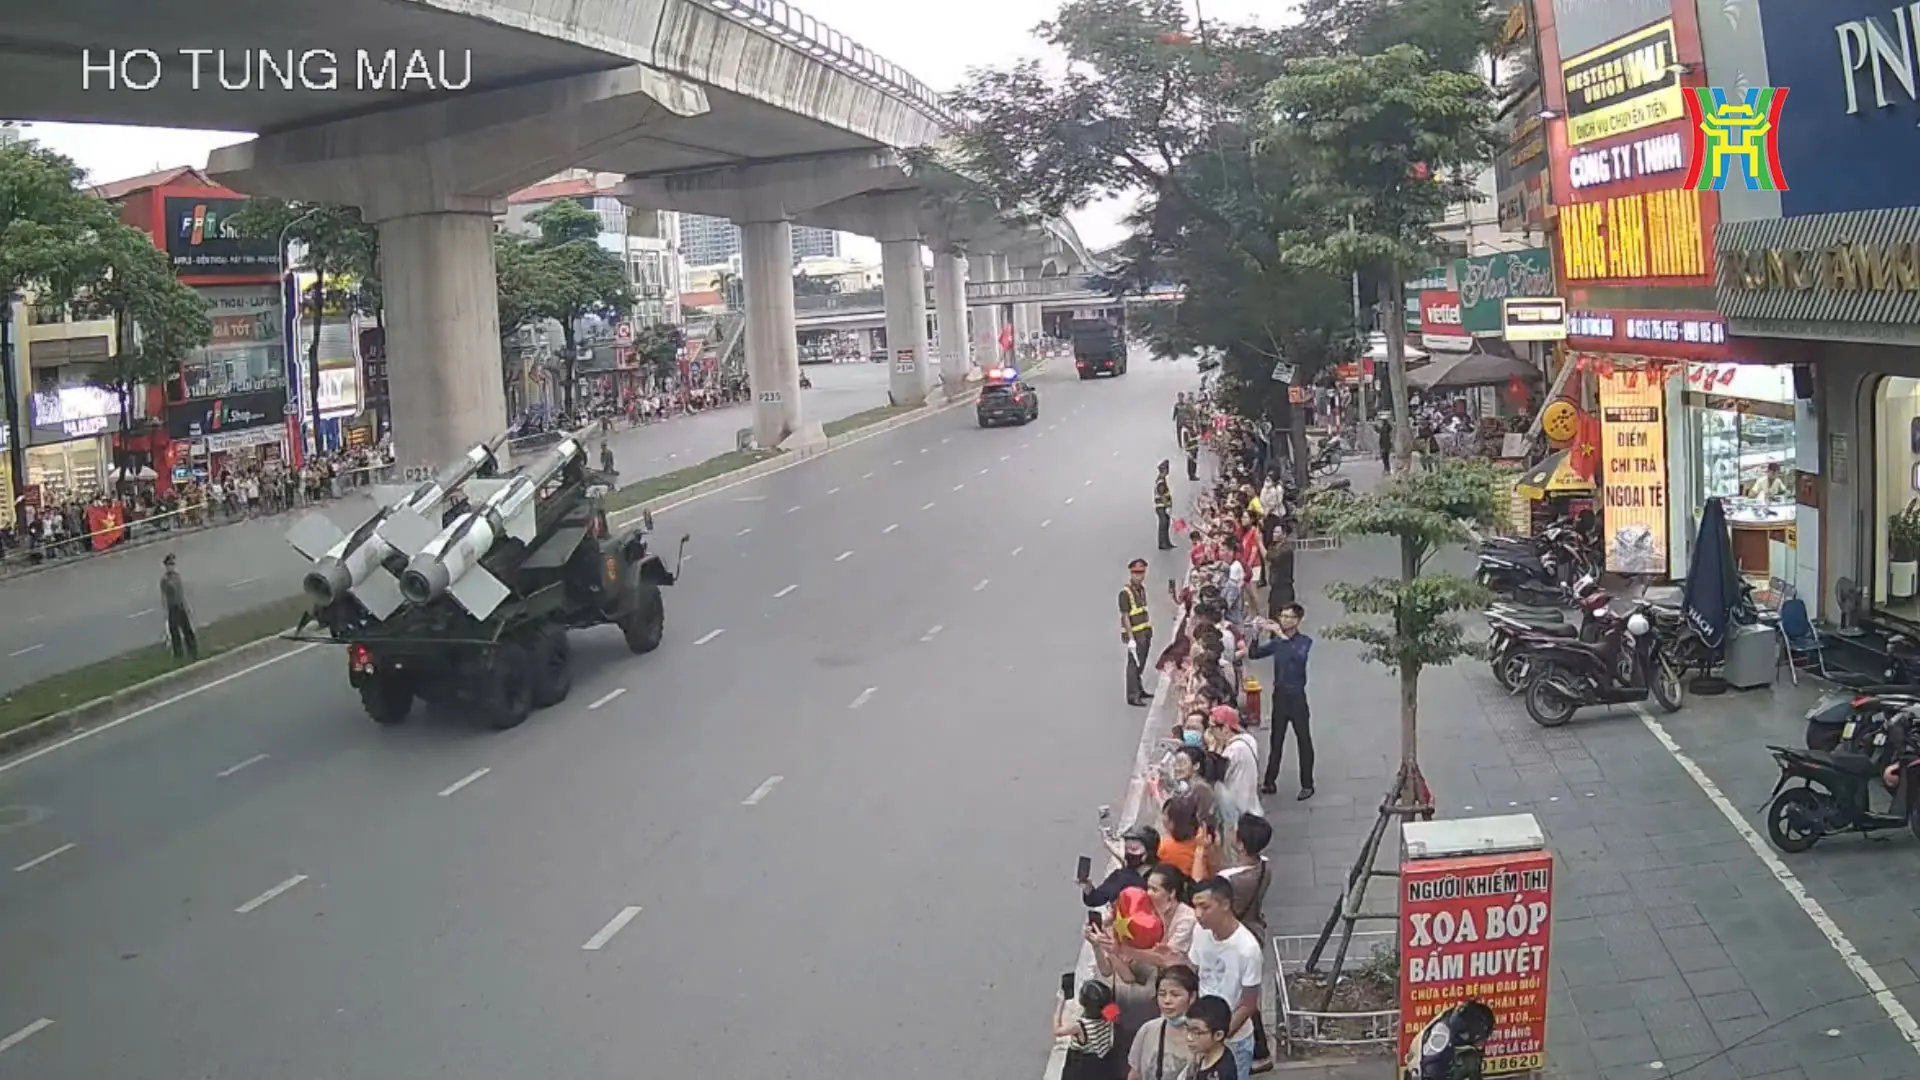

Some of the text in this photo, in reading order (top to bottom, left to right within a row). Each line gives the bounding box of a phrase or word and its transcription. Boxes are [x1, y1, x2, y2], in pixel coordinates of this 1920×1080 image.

[1566, 58, 1622, 92] WESTERN
[1584, 75, 1624, 104] UNION
[1569, 147, 1610, 189] CÔNG
[1611, 144, 1630, 179] TY
[1633, 132, 1682, 174] TNHH
[1608, 198, 1646, 277] ANH
[1647, 188, 1704, 276] MINH
[1611, 458, 1630, 473] CHI
[1409, 867, 1548, 902] NGƯỜI KHIẾM THỊ
[1409, 894, 1548, 947] XOA BÓP
[1410, 942, 1544, 984] BẤM HUYỆT
[1442, 983, 1464, 998] CÁC
[1521, 1039, 1540, 1051] CÂY
